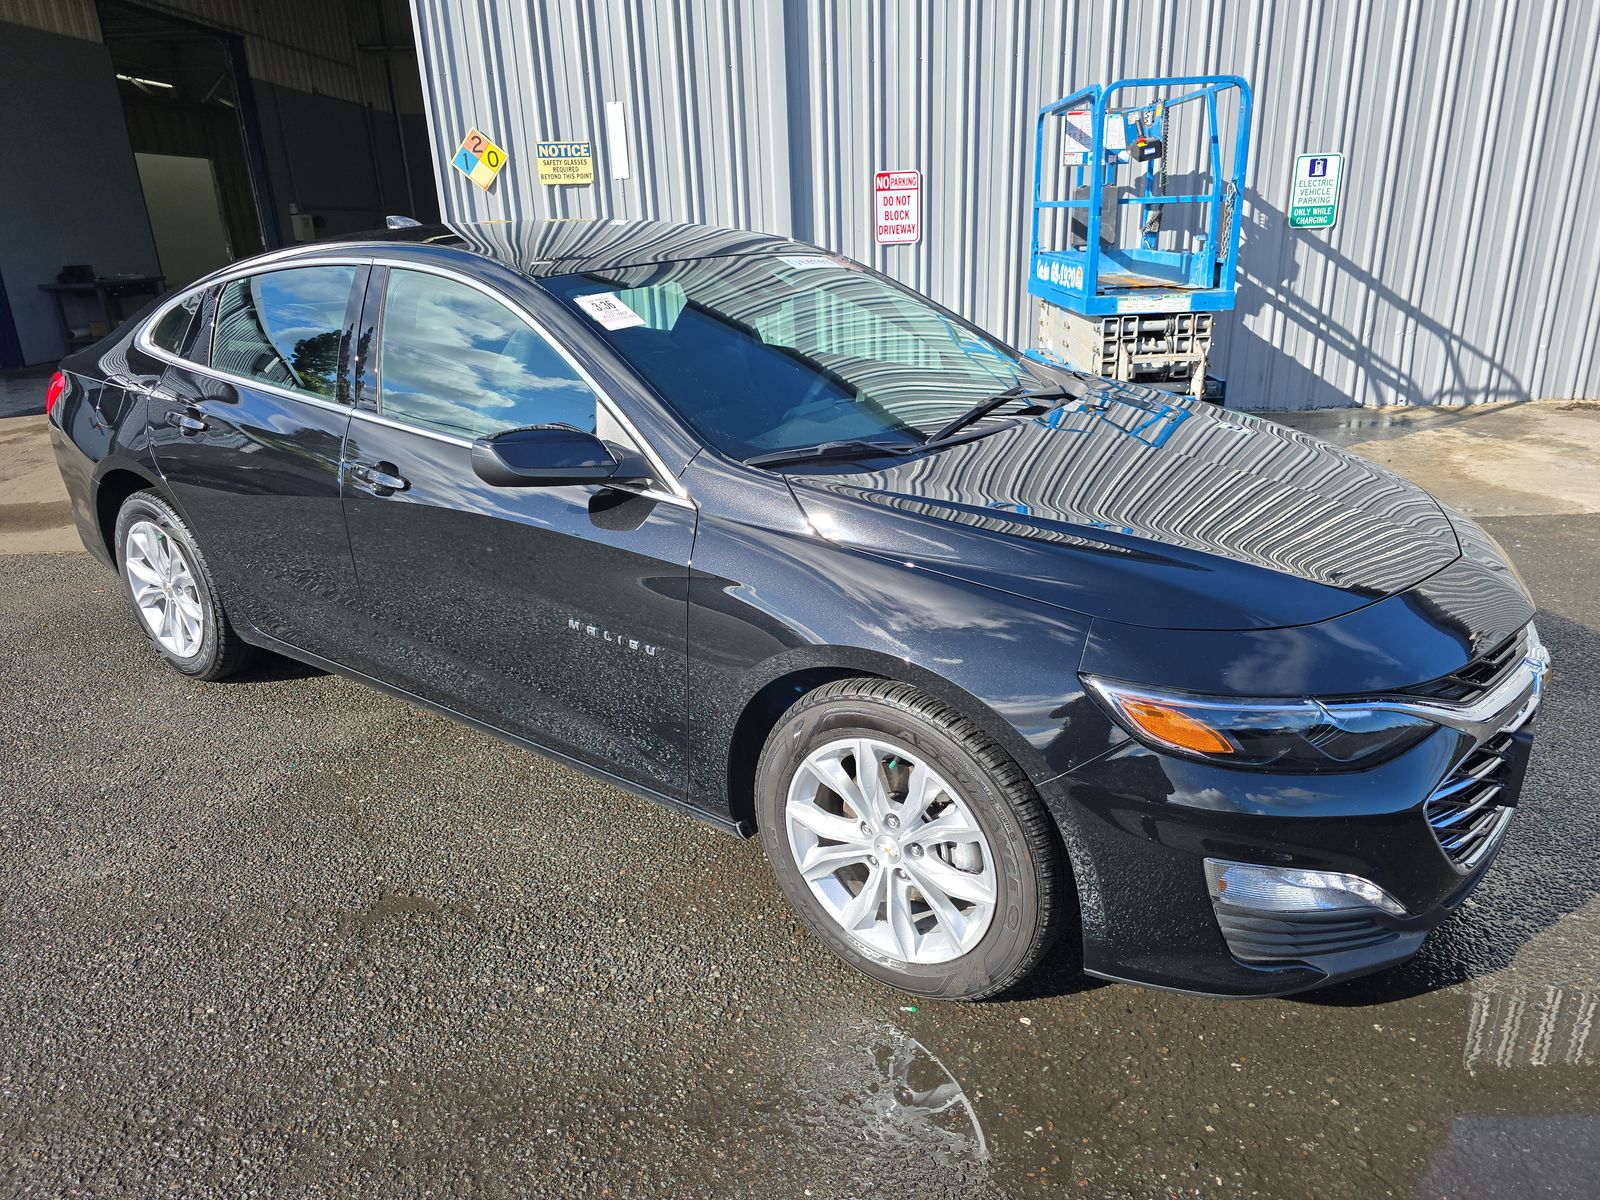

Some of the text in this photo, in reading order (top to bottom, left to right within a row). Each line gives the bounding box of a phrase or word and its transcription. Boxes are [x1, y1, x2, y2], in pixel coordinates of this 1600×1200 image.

[471, 135, 483, 153] 2
[538, 144, 590, 157] NOTICE
[463, 153, 470, 171] 1
[487, 150, 499, 168] 0
[876, 177, 917, 189] NO PARKING
[1299, 179, 1334, 187] ELECTRIC
[1300, 188, 1331, 196] VEHICLE
[883, 195, 911, 206] DO NOT
[884, 210, 910, 220] BLOCK
[1294, 207, 1332, 216] ONLY WHILE
[1295, 216, 1328, 225] CHARGING
[878, 224, 916, 235] DRIVEWAY
[568, 618, 656, 657] MALIBU
